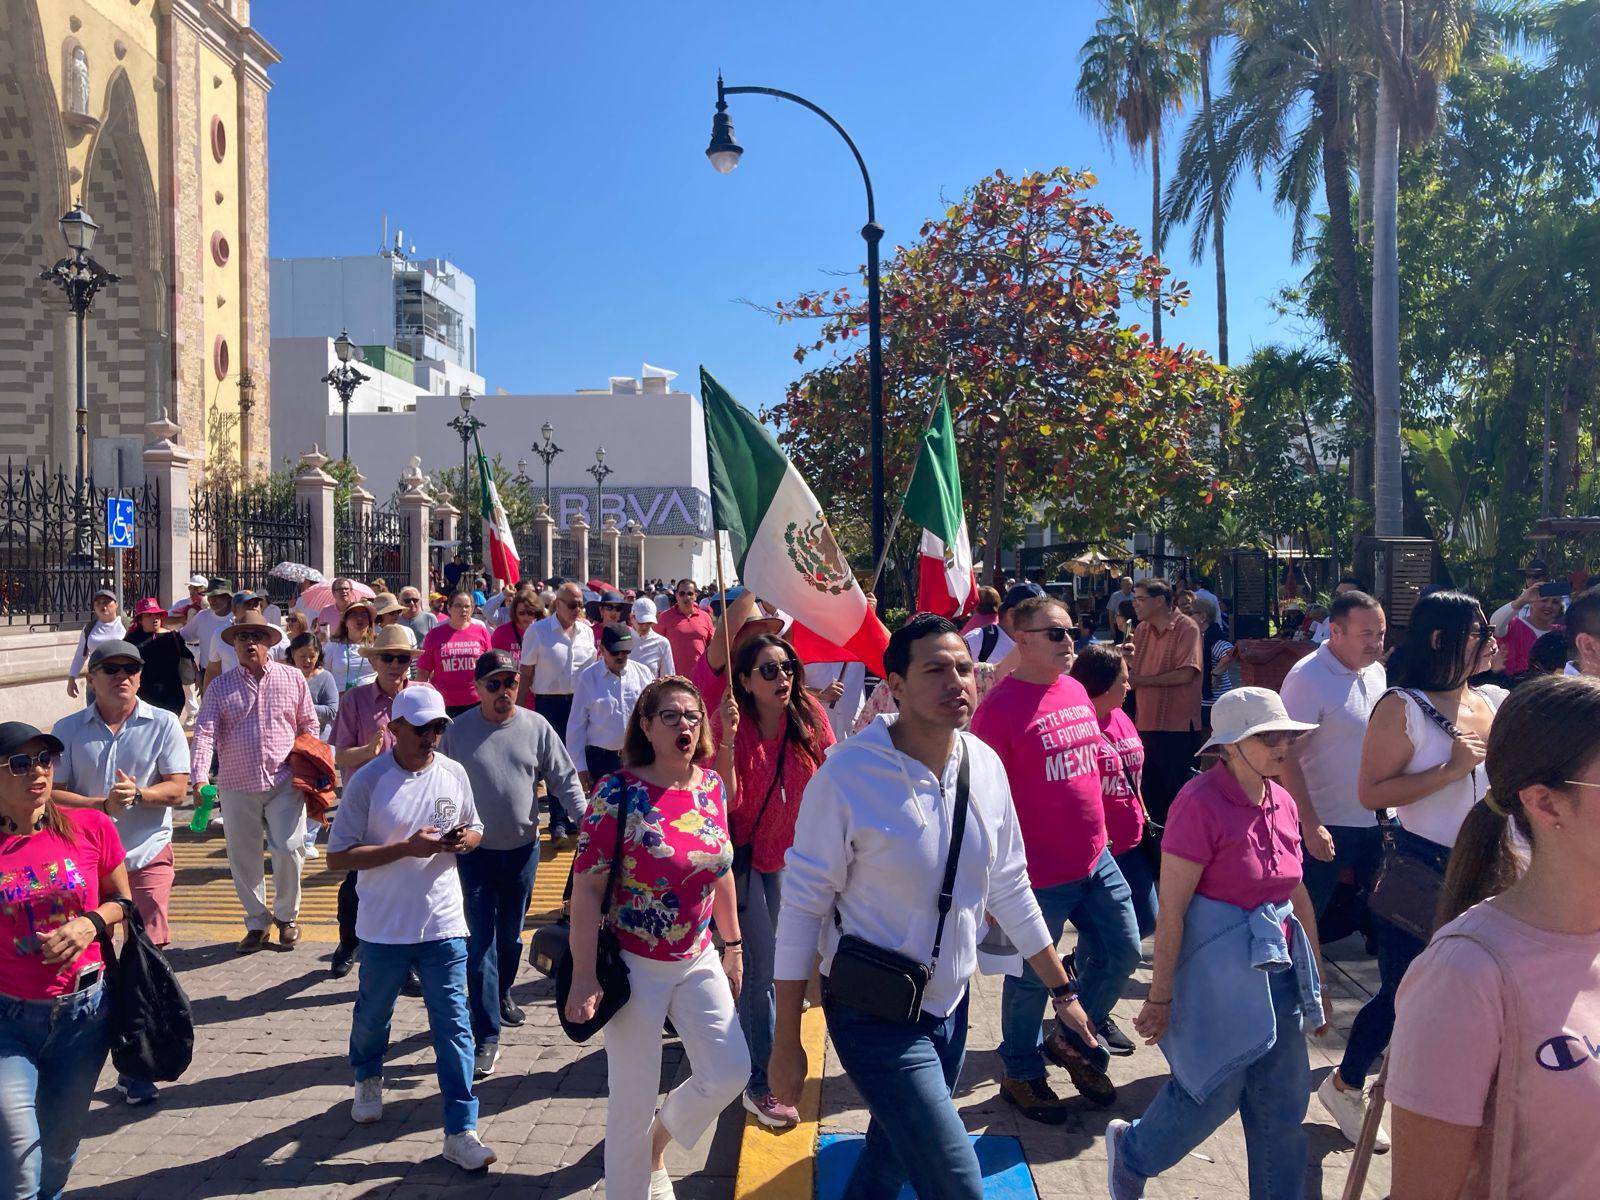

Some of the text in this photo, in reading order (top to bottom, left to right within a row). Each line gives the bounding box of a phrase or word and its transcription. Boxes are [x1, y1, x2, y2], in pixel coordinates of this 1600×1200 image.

[559, 488, 694, 530] BBVA
[449, 648, 473, 657] FUTURO
[442, 655, 477, 673] MÉXIC
[1046, 712, 1060, 728] TE
[1041, 733, 1058, 750] EL
[1057, 721, 1094, 745] FUTURO
[1045, 742, 1098, 782] MÉXIC
[1106, 758, 1117, 772] EL
